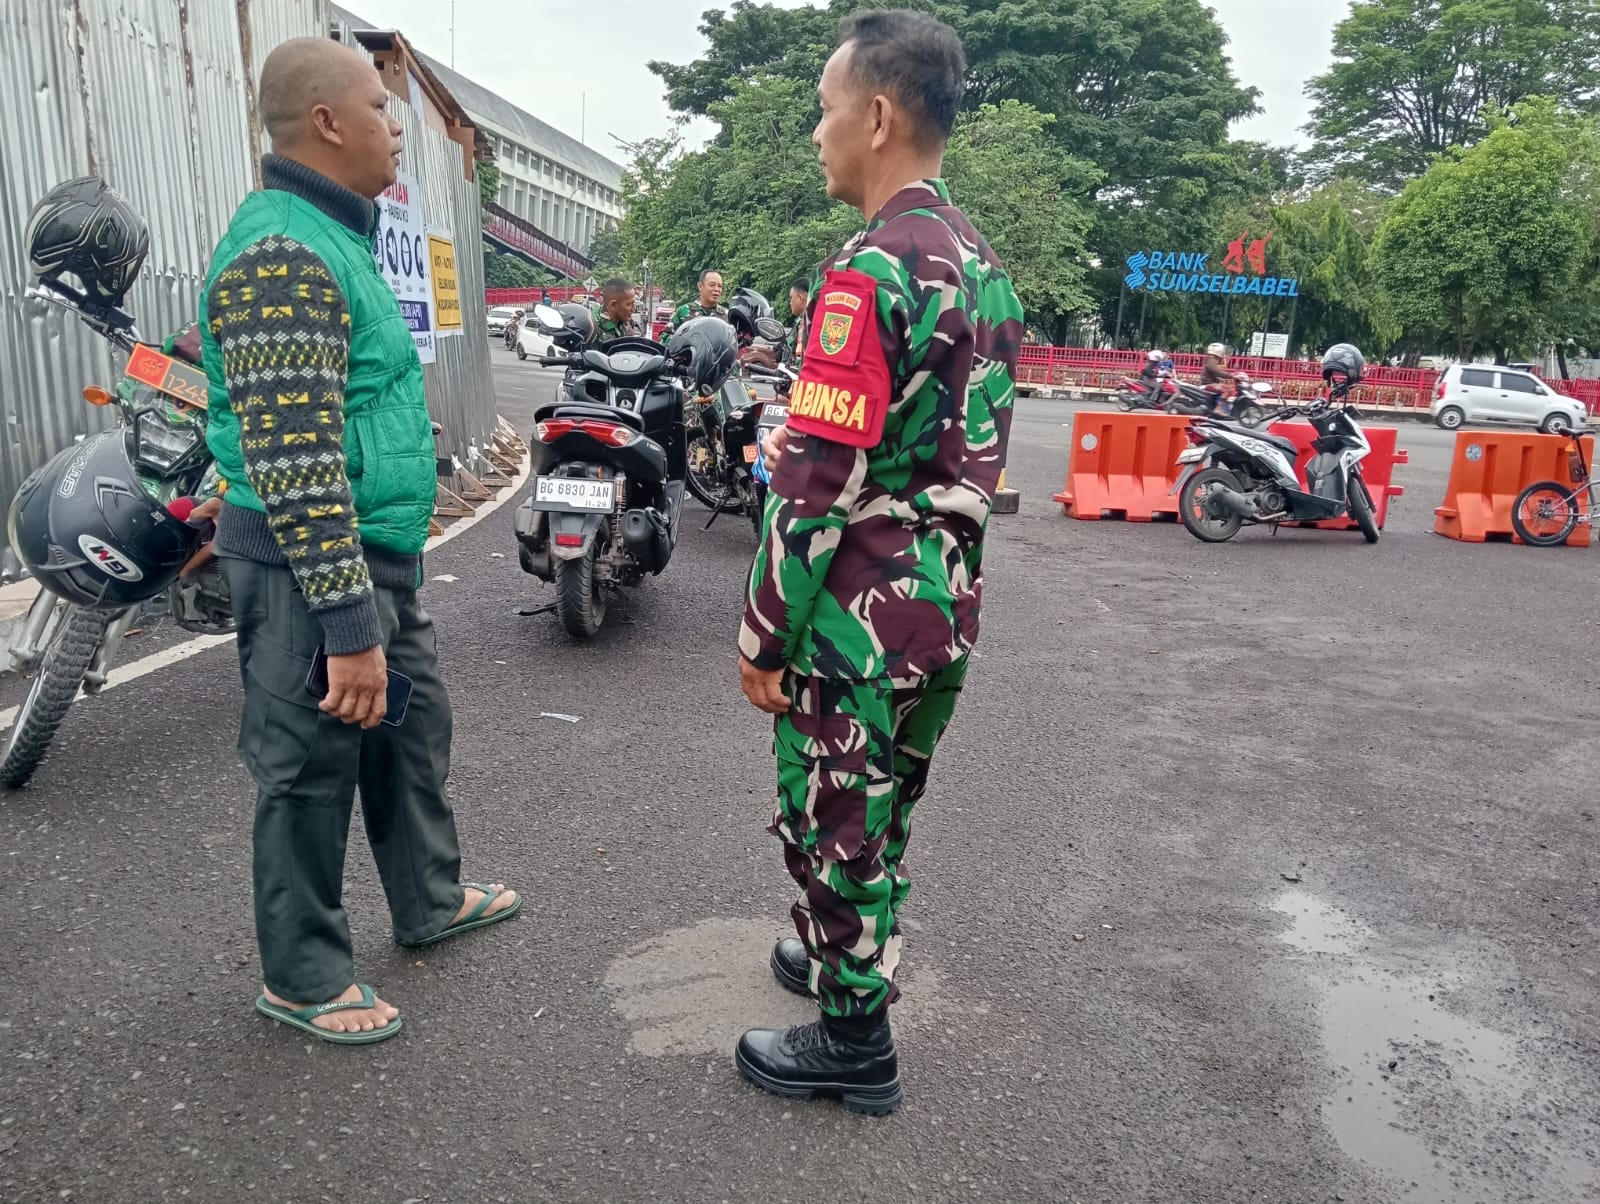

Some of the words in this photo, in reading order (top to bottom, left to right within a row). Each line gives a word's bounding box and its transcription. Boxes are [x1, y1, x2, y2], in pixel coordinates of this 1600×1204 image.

[1149, 251, 1209, 271] BANK
[1146, 273, 1299, 297] SUMSELBABEL
[540, 481, 553, 494] BG
[558, 484, 585, 496] 6830
[590, 486, 609, 498] JAN
